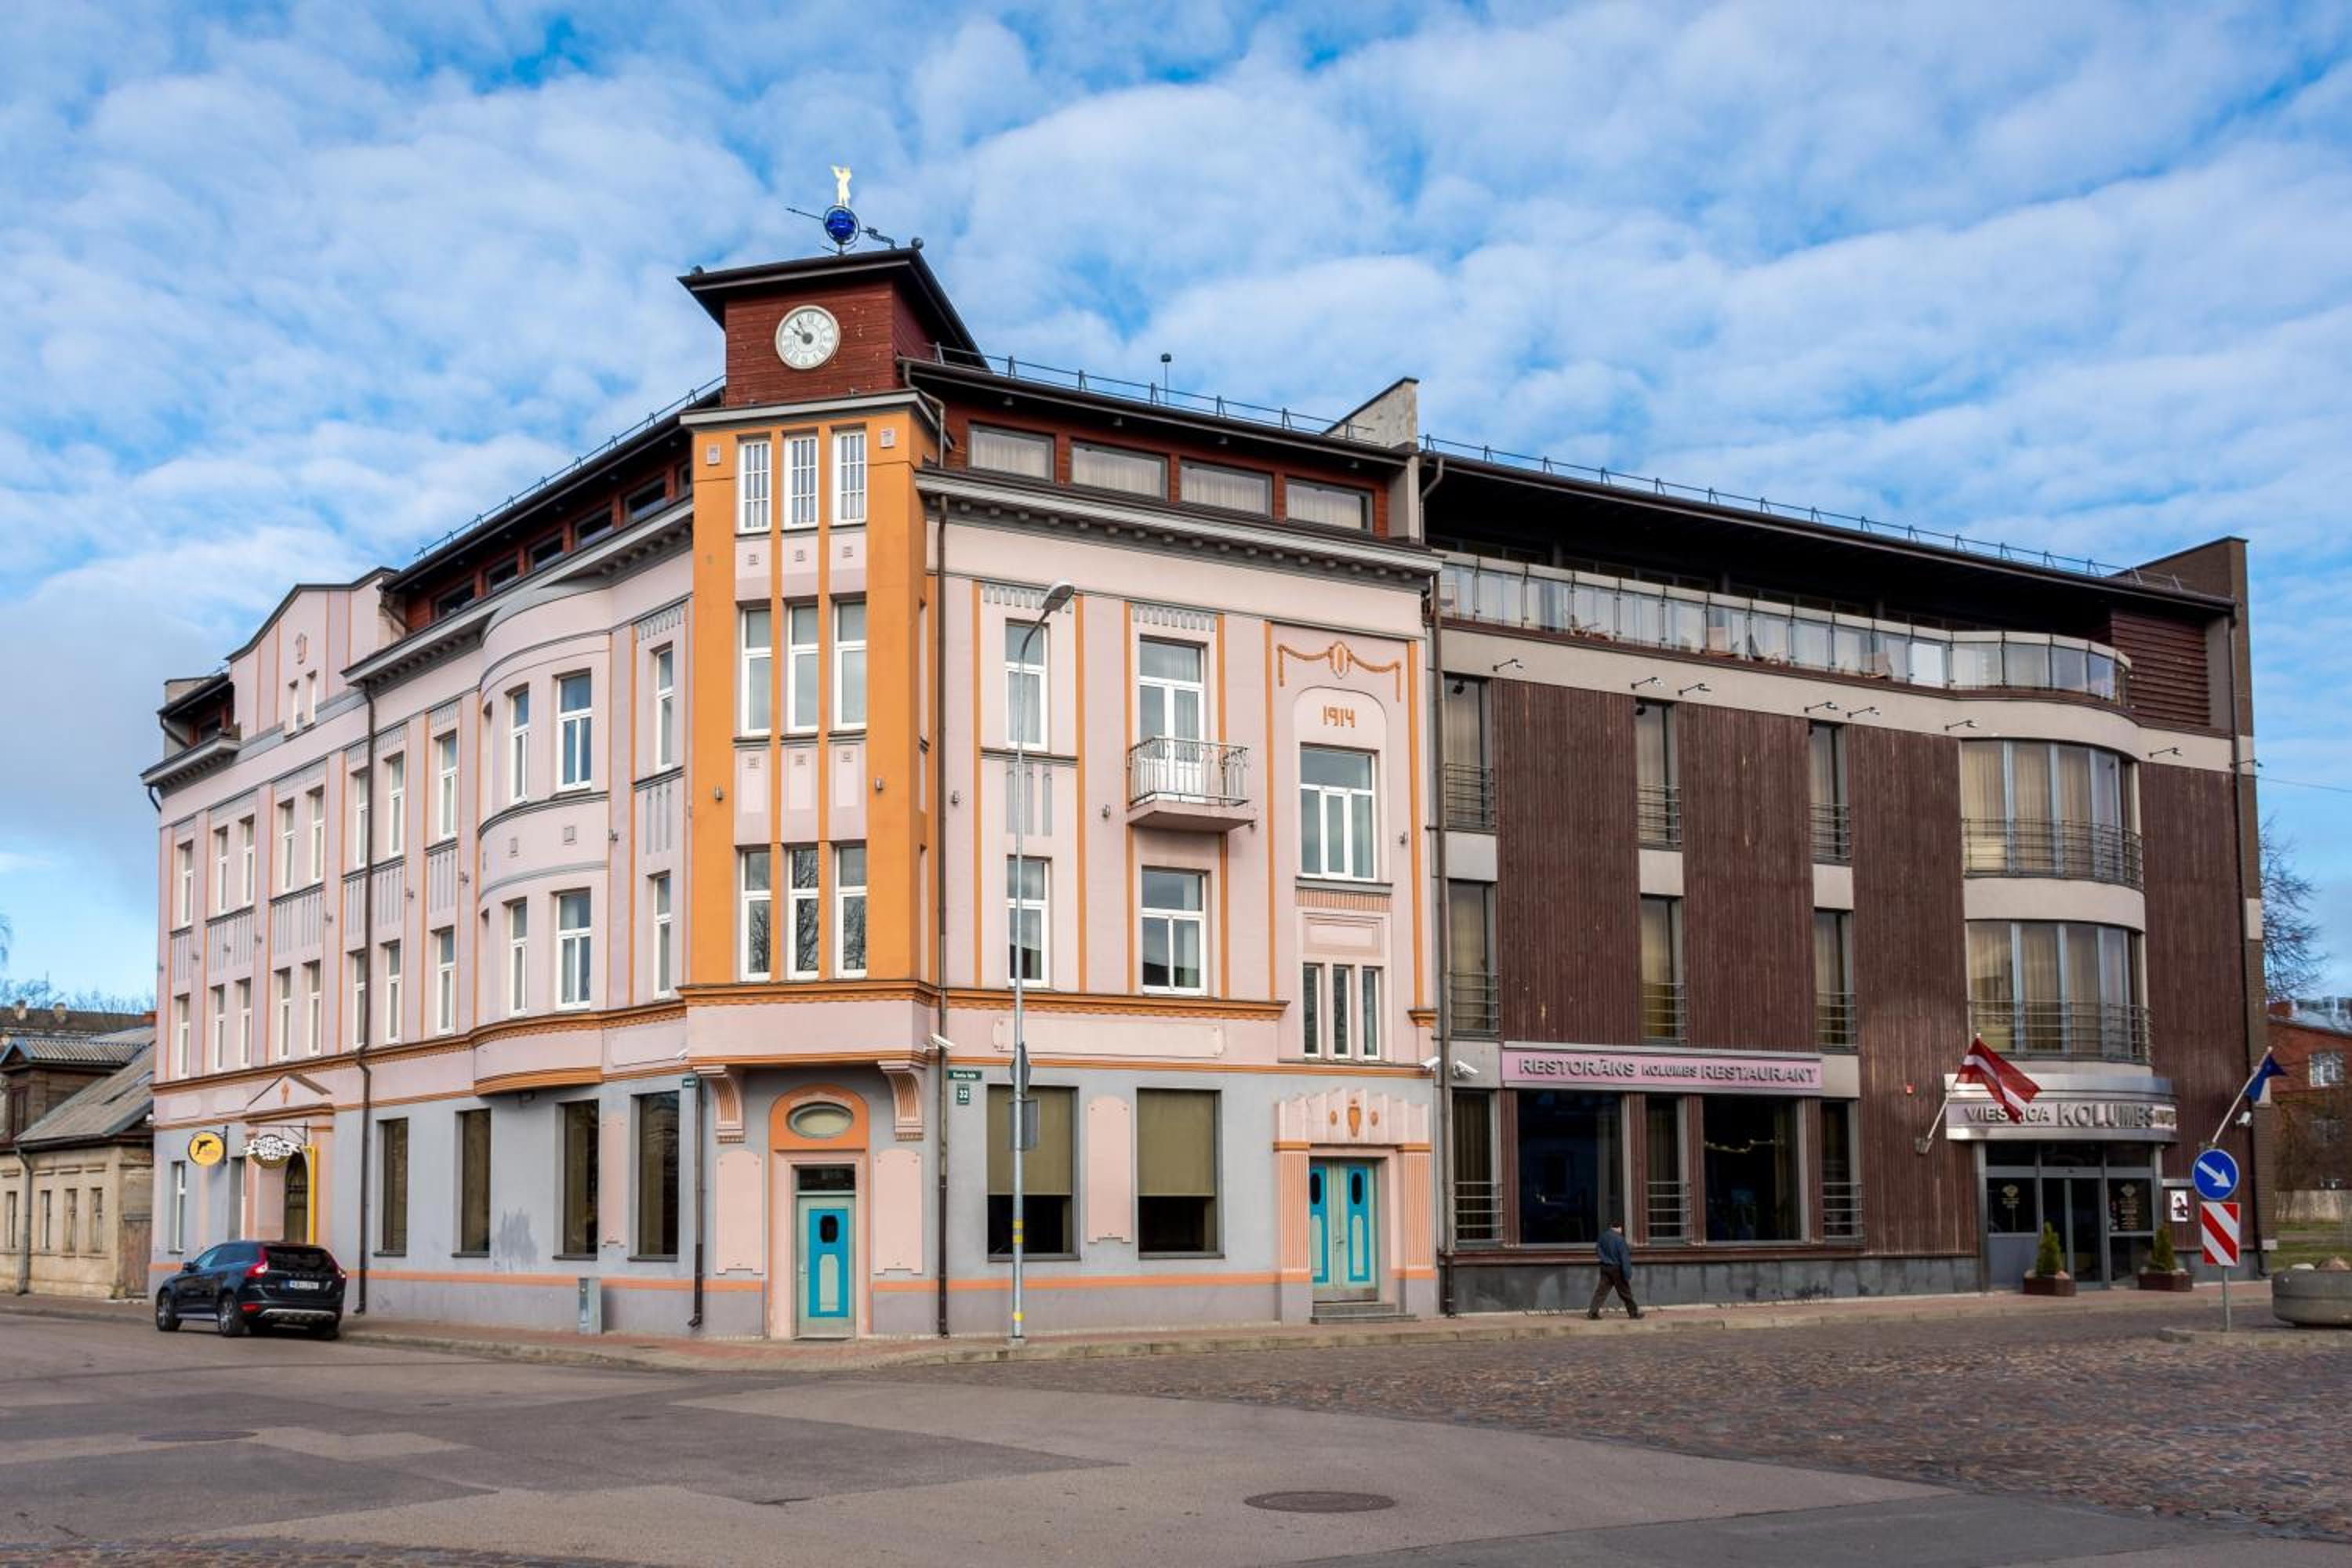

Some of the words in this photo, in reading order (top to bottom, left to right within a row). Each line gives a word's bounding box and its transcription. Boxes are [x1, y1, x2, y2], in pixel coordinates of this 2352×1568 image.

[1323, 705, 1356, 728] 1914
[1519, 1058, 1635, 1077] RESTORĀNS
[1641, 1064, 1697, 1077] KOLUMBS
[1700, 1065, 1817, 1082] RESTAURANT
[2056, 1103, 2154, 1127] KOLUMBS
